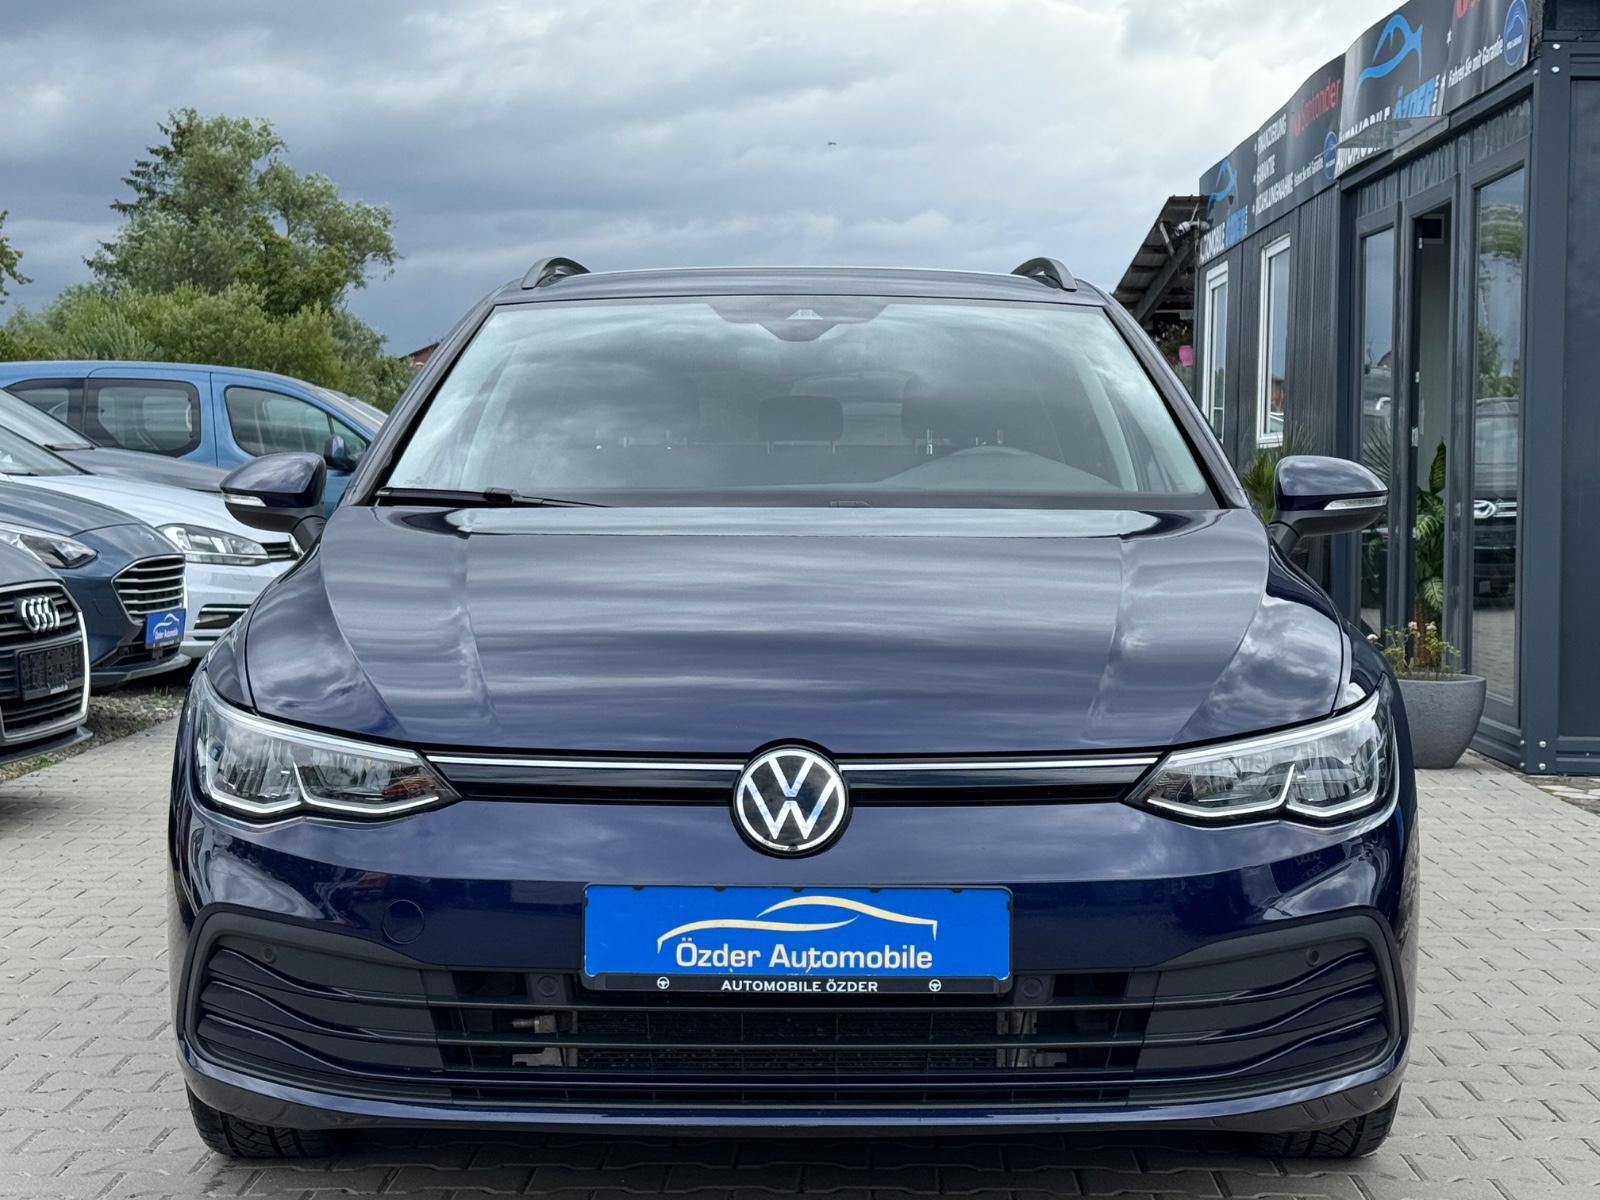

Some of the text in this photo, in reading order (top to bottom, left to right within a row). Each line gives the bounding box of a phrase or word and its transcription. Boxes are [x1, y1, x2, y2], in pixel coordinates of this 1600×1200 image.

[1448, 65, 1464, 88] Fahren
[1464, 56, 1472, 77] Sie
[1482, 33, 1503, 66] Garantie
[740, 751, 842, 847] VW
[676, 937, 934, 969] Özder Automobile
[721, 978, 879, 992] AUTOMOBILE ÖZDER
